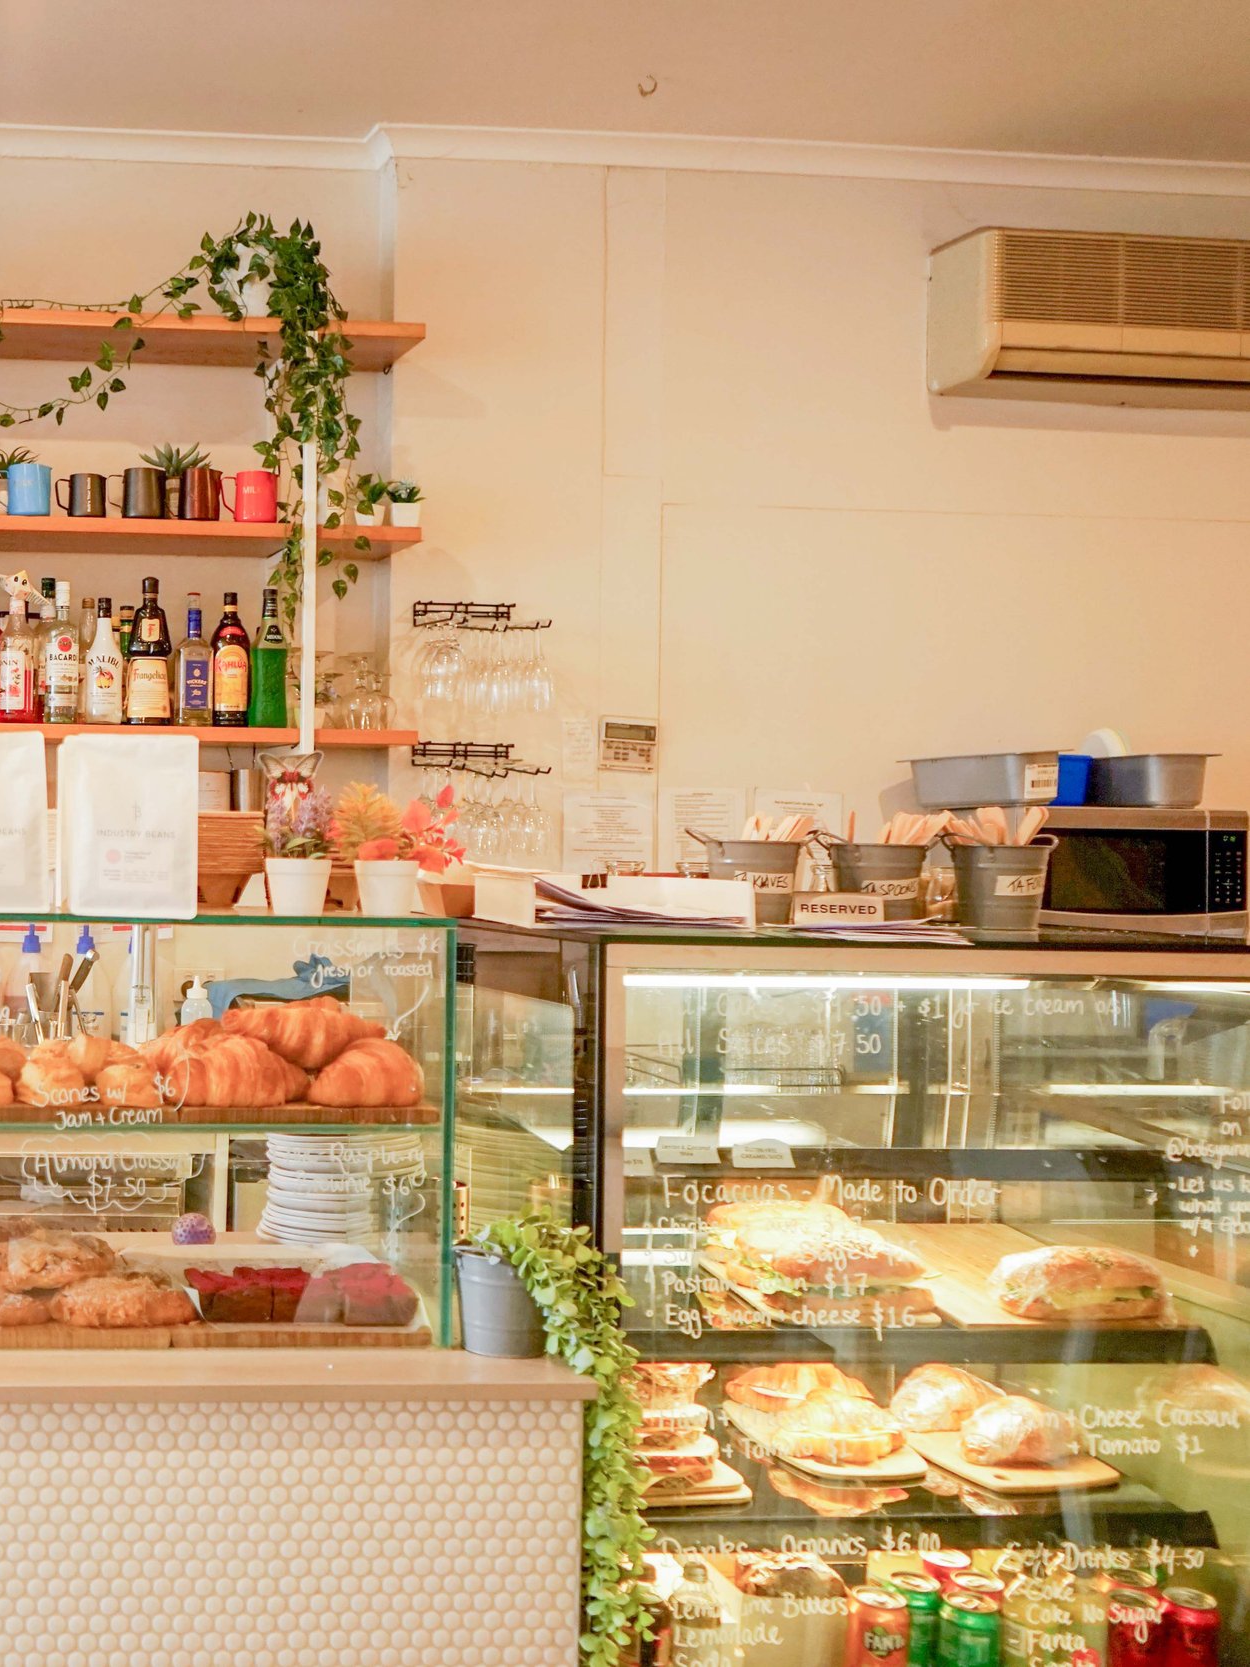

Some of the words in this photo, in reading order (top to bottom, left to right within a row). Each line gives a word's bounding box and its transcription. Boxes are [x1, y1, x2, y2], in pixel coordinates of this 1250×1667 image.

[88, 655, 120, 670] MALIBU
[0, 827, 27, 836] BEANS
[97, 829, 141, 839] INDUSTRY
[145, 829, 175, 840] BEANS
[1008, 880, 1025, 891] TA
[800, 903, 877, 915] RESERVED
[357, 965, 374, 977] or
[31, 1084, 100, 1107] Scones
[55, 1112, 92, 1130] Jam
[95, 1113, 106, 1125] +
[109, 1107, 163, 1125] Cream
[35, 1150, 116, 1186] Almond
[821, 1175, 884, 1206] Made
[896, 1178, 918, 1203] to
[928, 1178, 1001, 1206] Order
[824, 1268, 869, 1299] $17
[665, 1303, 702, 1340] Egg
[790, 1305, 861, 1328] cheese
[872, 1300, 916, 1342] $16
[1080, 1403, 1144, 1429] Cheese
[1086, 1433, 1161, 1457] Tomato
[1177, 1432, 1205, 1464] $1
[781, 1533, 868, 1557] Organics
[1061, 1541, 1131, 1570] Drinks
[673, 1622, 784, 1648] Lemonade
[1026, 1603, 1073, 1626] Coke
[1082, 1604, 1105, 1622] No
[1109, 1603, 1163, 1644] Sugar
[1027, 1630, 1086, 1654] Fanta
